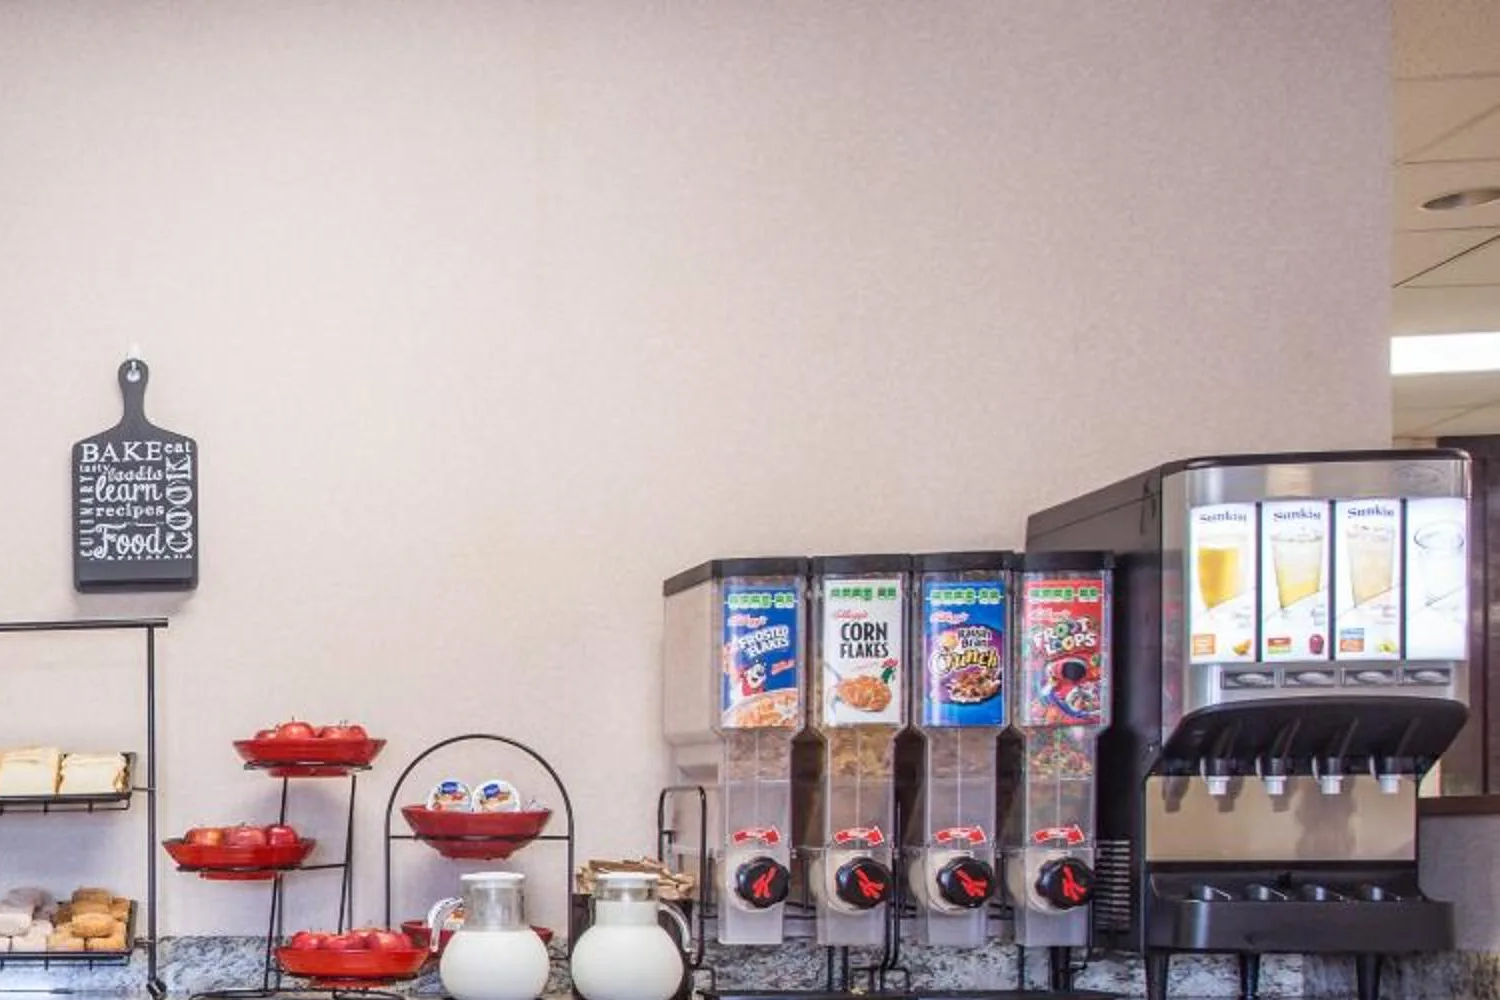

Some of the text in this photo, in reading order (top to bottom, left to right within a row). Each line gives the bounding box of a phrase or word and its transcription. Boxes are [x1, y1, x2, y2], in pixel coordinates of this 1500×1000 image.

[80, 441, 163, 463] BAKE
[164, 441, 192, 454] eat
[95, 475, 164, 503] learn
[95, 503, 165, 519] recipes
[166, 454, 193, 553] COOK
[79, 475, 95, 557] CULINARY
[93, 522, 167, 559] Food
[841, 621, 888, 641] CORN
[840, 642, 889, 659] FLAKES
